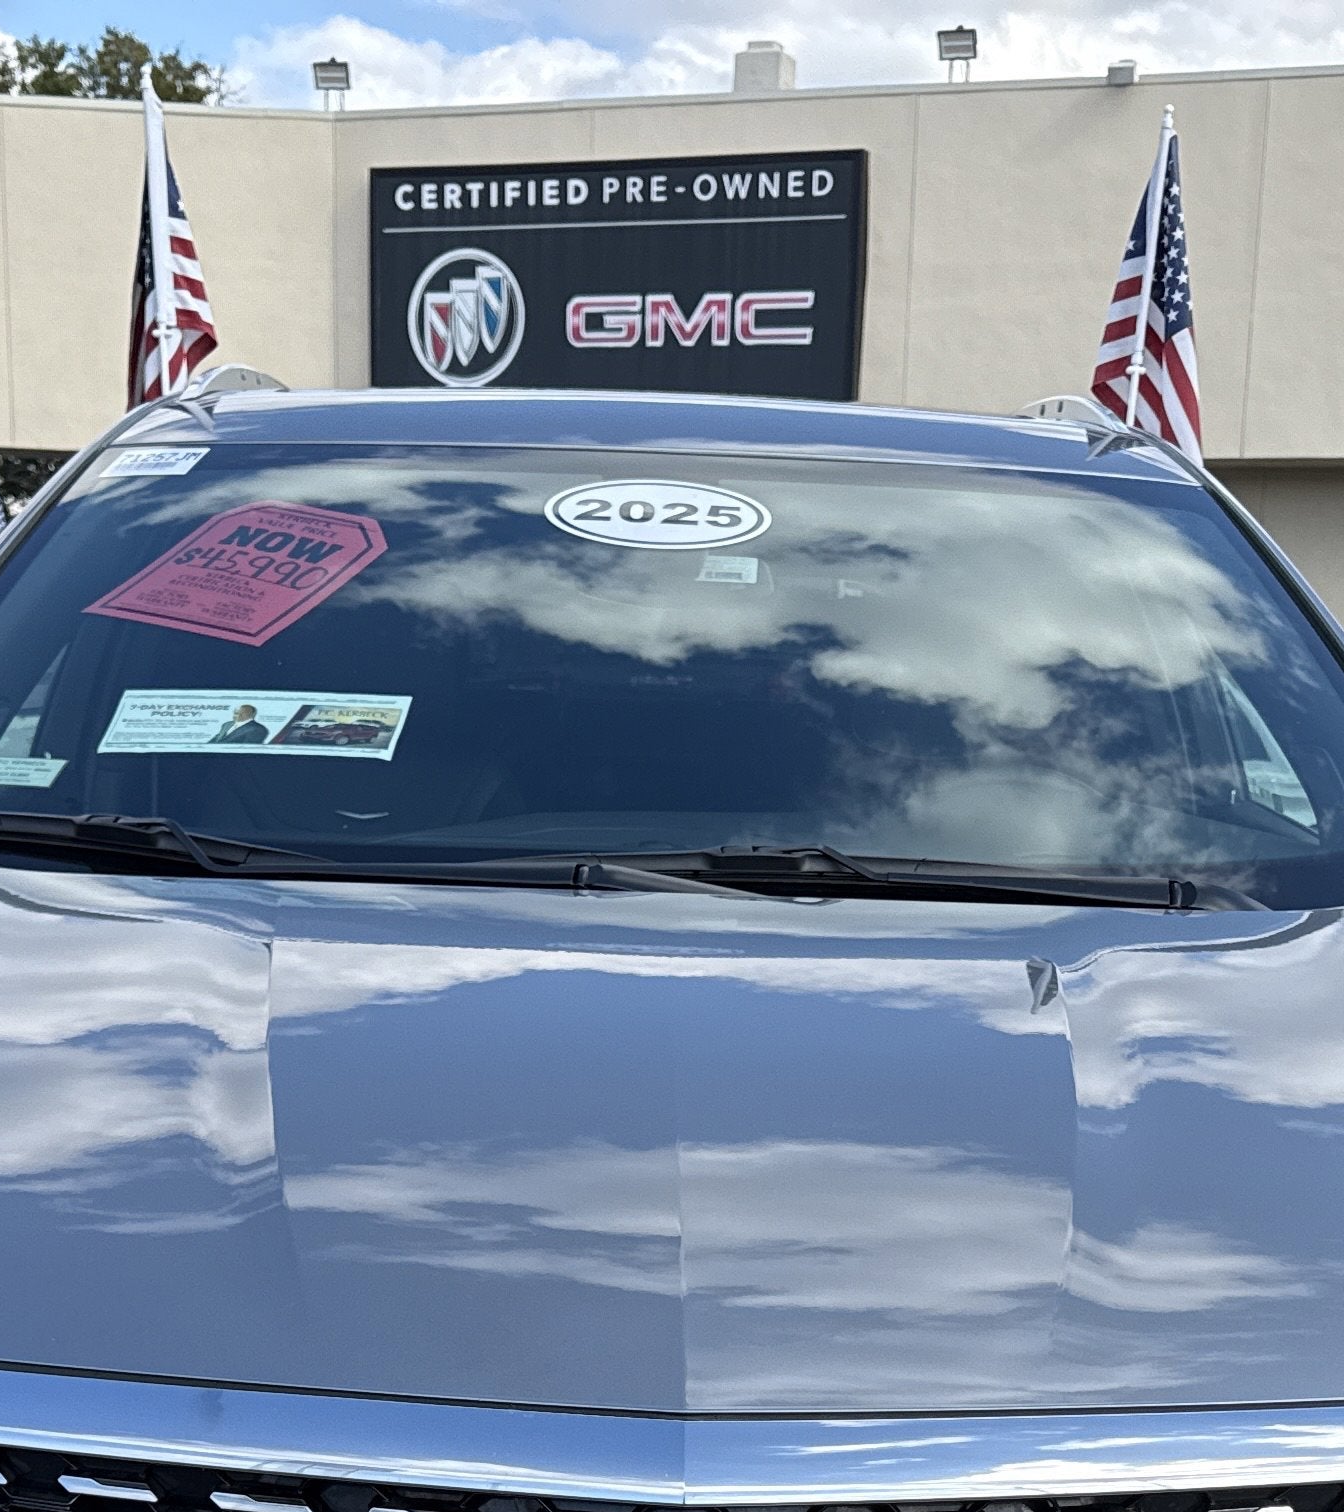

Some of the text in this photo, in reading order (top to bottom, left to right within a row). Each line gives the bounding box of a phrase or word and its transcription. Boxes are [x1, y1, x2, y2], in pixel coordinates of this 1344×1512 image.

[394, 169, 835, 211] CERTIFIED PRE-OWNED
[566, 290, 815, 347] GMC
[572, 498, 743, 529] 2025
[217, 525, 345, 564] NOW
